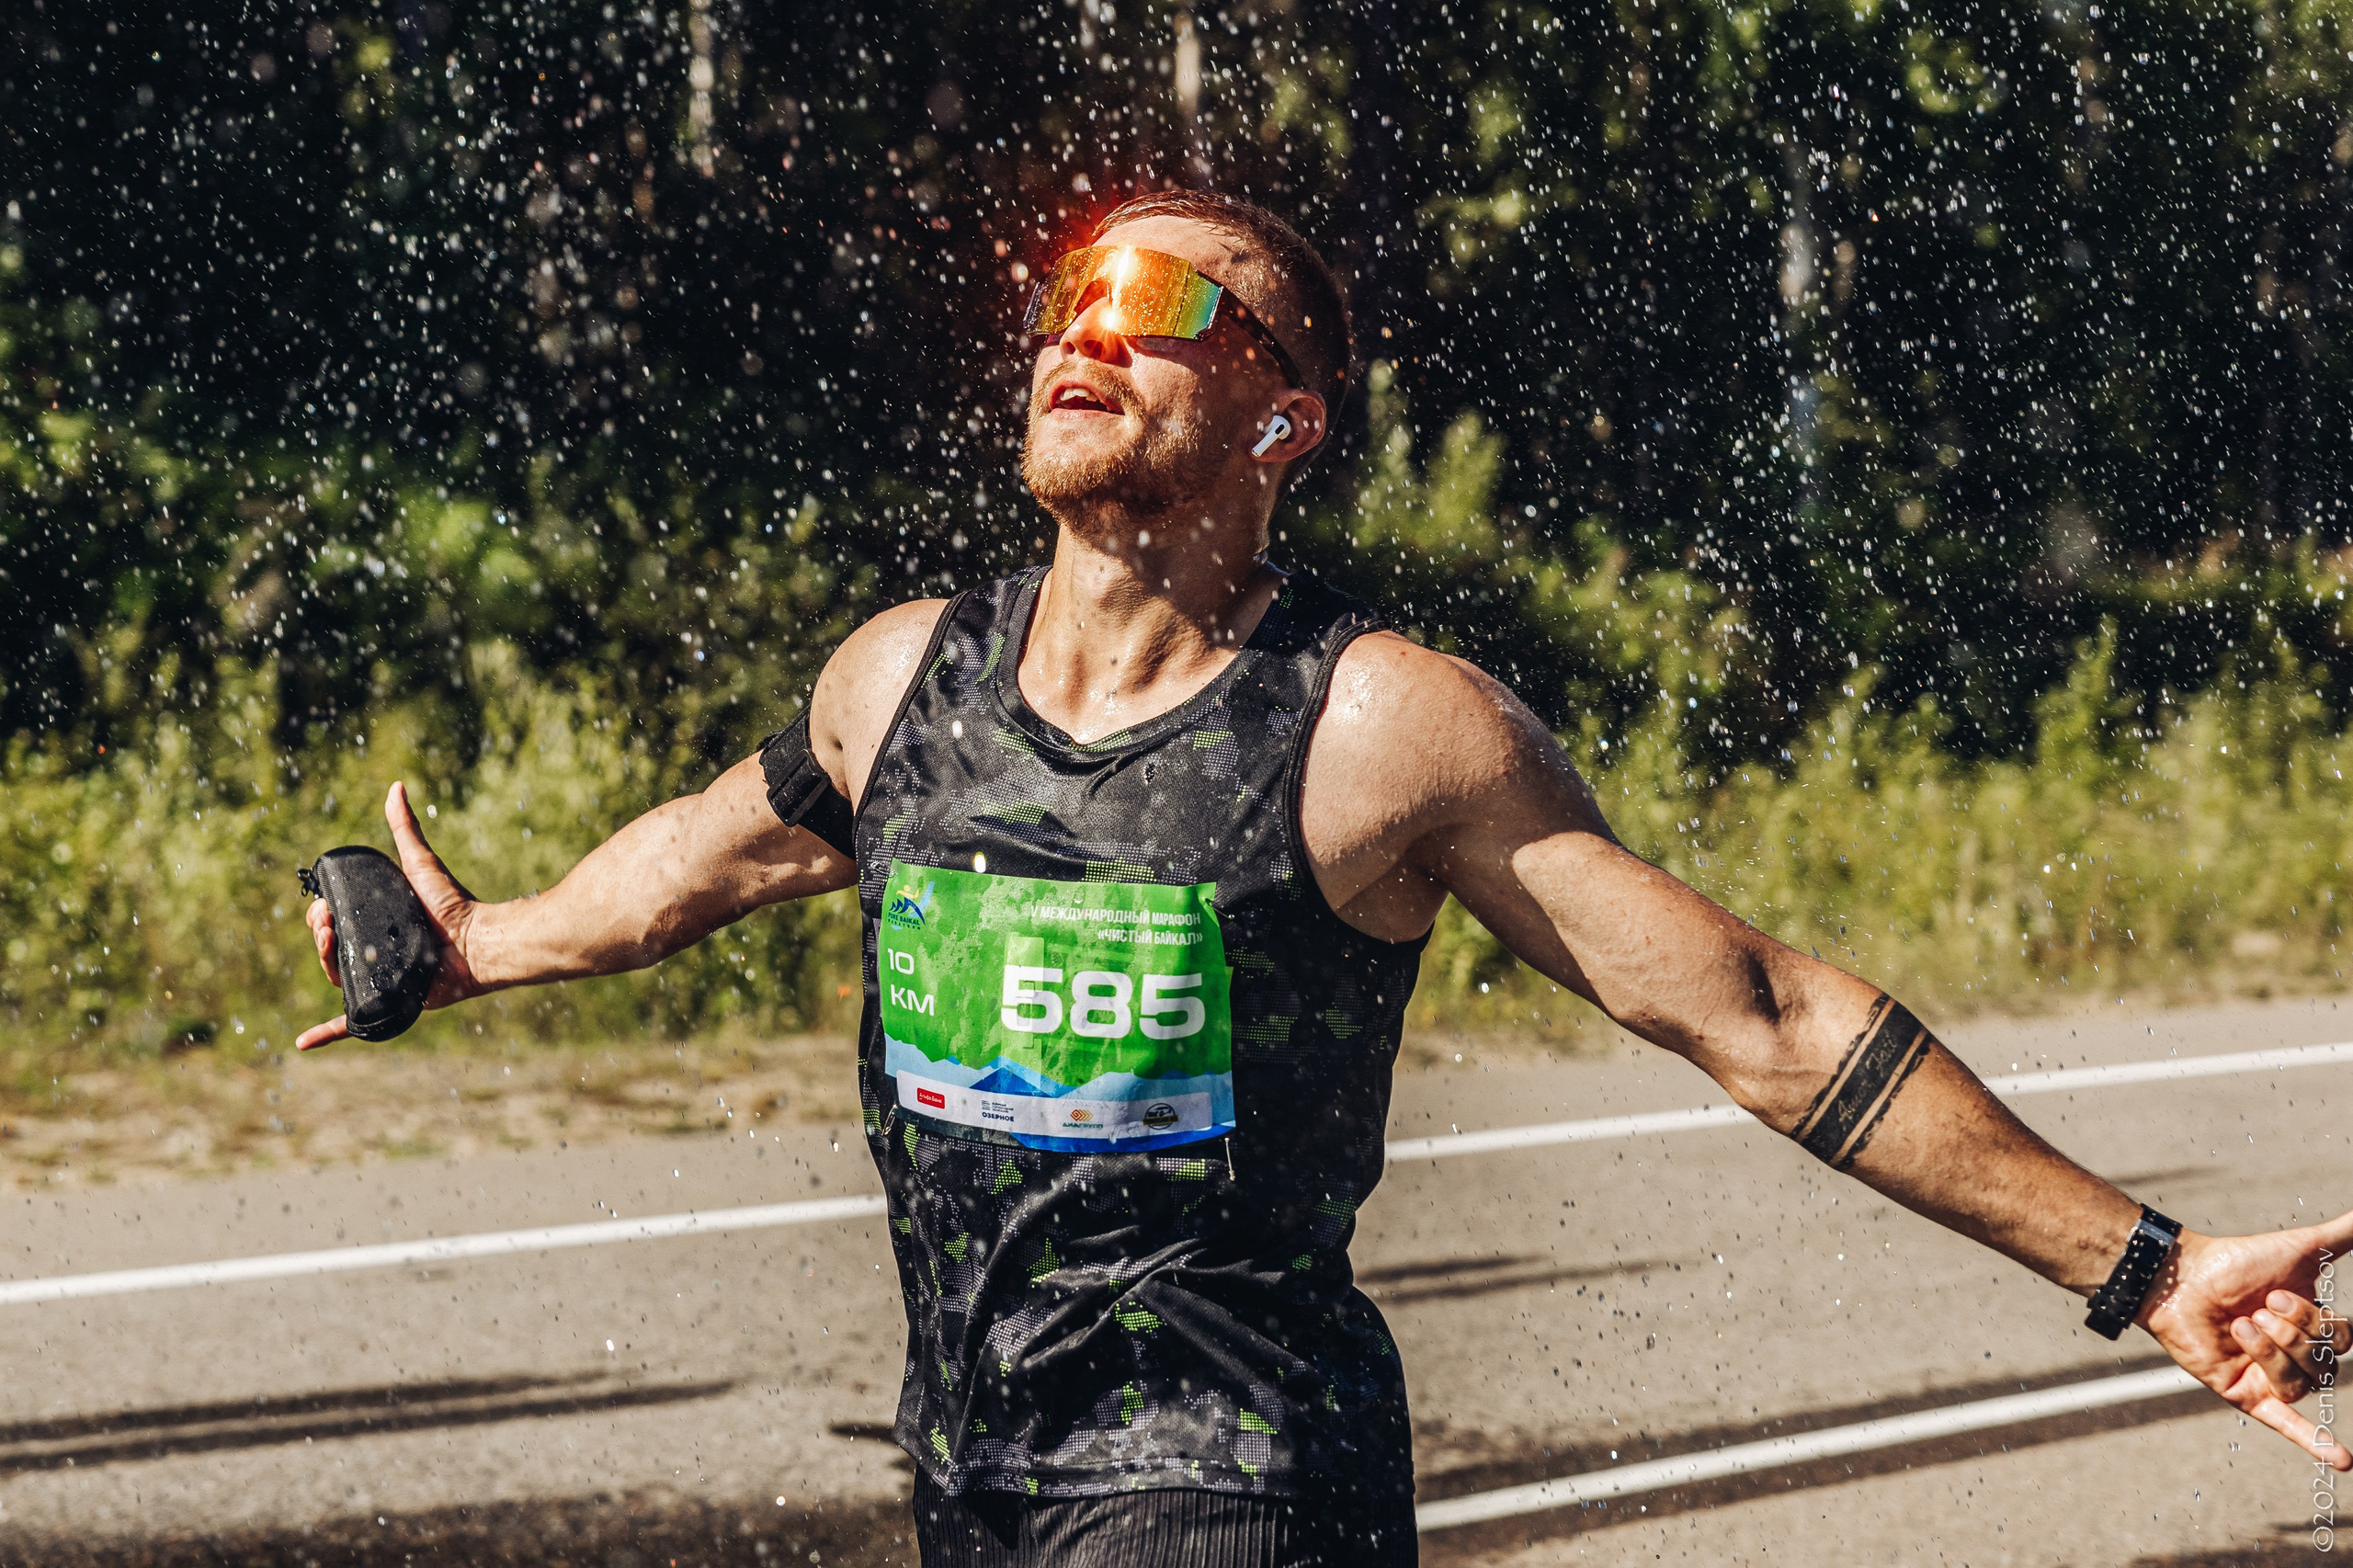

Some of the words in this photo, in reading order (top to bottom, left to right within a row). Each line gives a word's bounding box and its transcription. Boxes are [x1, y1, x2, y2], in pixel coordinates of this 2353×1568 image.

[1040, 906, 1150, 924] МЕЖДУНАРОДНЫЙ
[1152, 912, 1201, 926] МАРАФОН
[1098, 928, 1153, 945] «ЧИСТЫЙ
[1154, 931, 1203, 947] БАЙКАЛ»
[888, 948, 915, 975] 10
[1001, 966, 1206, 1040] 585
[982, 1111, 1015, 1122] ОЗЕРНОЕ
